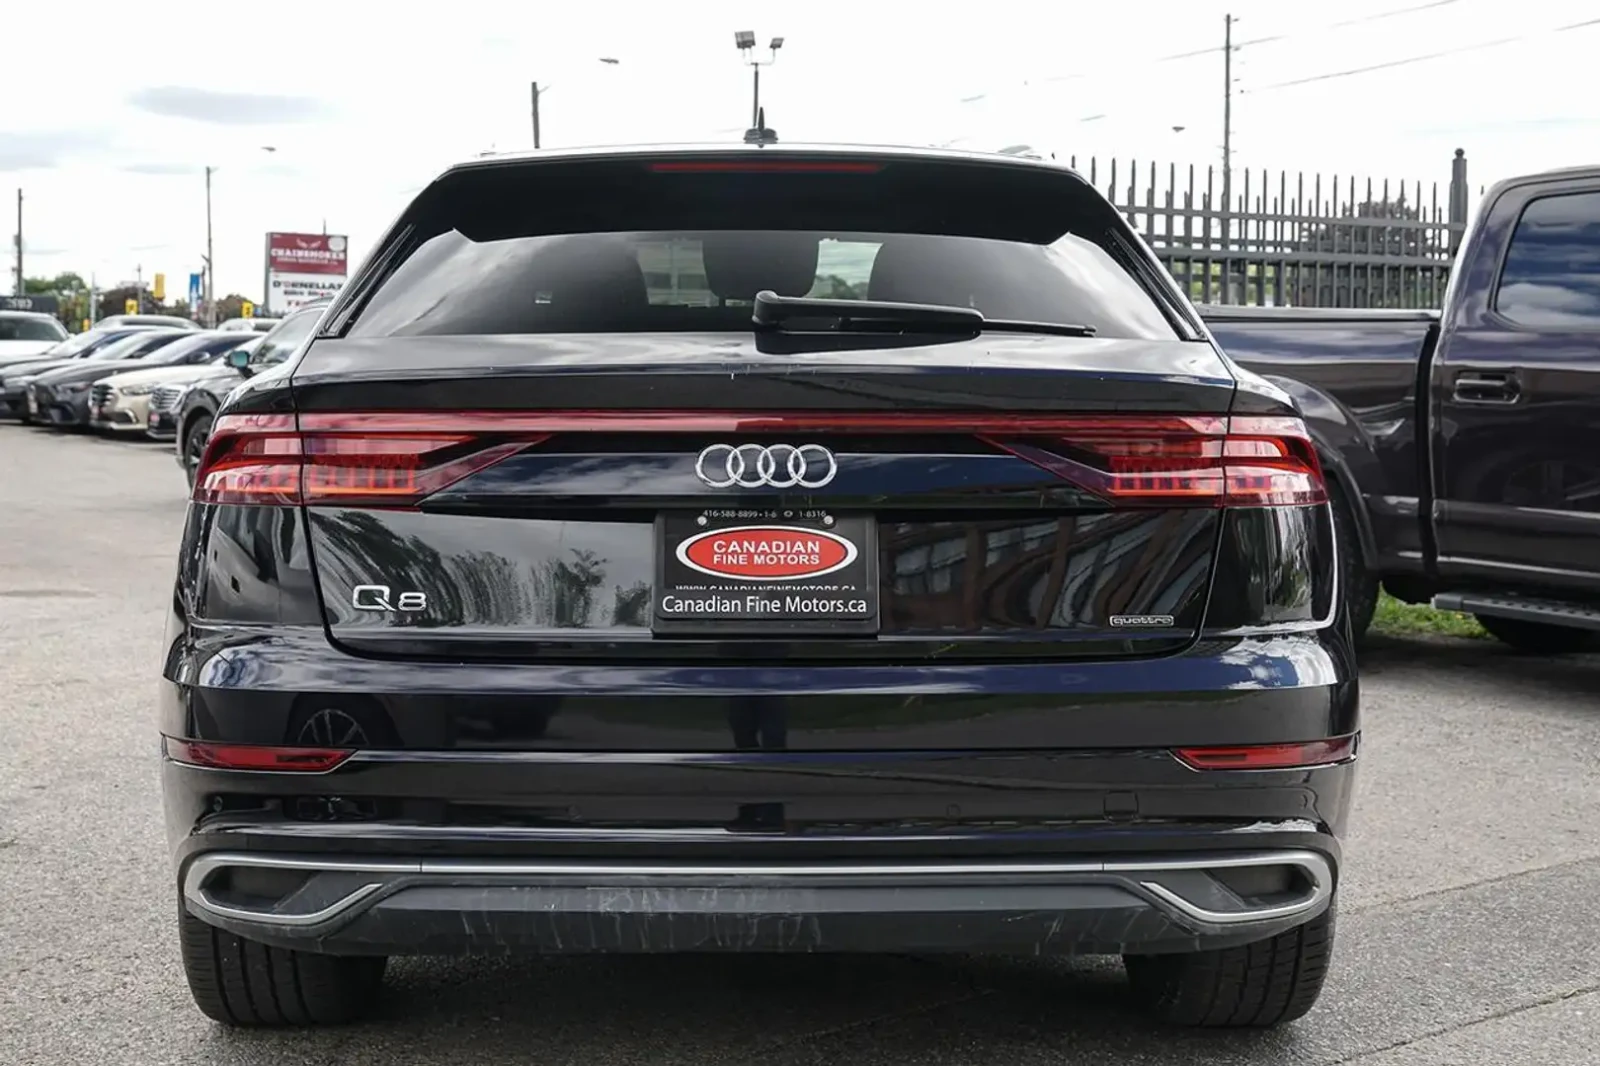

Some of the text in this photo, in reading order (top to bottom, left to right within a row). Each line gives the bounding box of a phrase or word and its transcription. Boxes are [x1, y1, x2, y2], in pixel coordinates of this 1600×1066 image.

[713, 540, 820, 554] CANADIAN
[713, 554, 820, 565] FINE MOTORS
[352, 584, 427, 612] Q8
[662, 595, 867, 613] Canadian Fine Motors.ca
[1113, 616, 1171, 626] quattro
